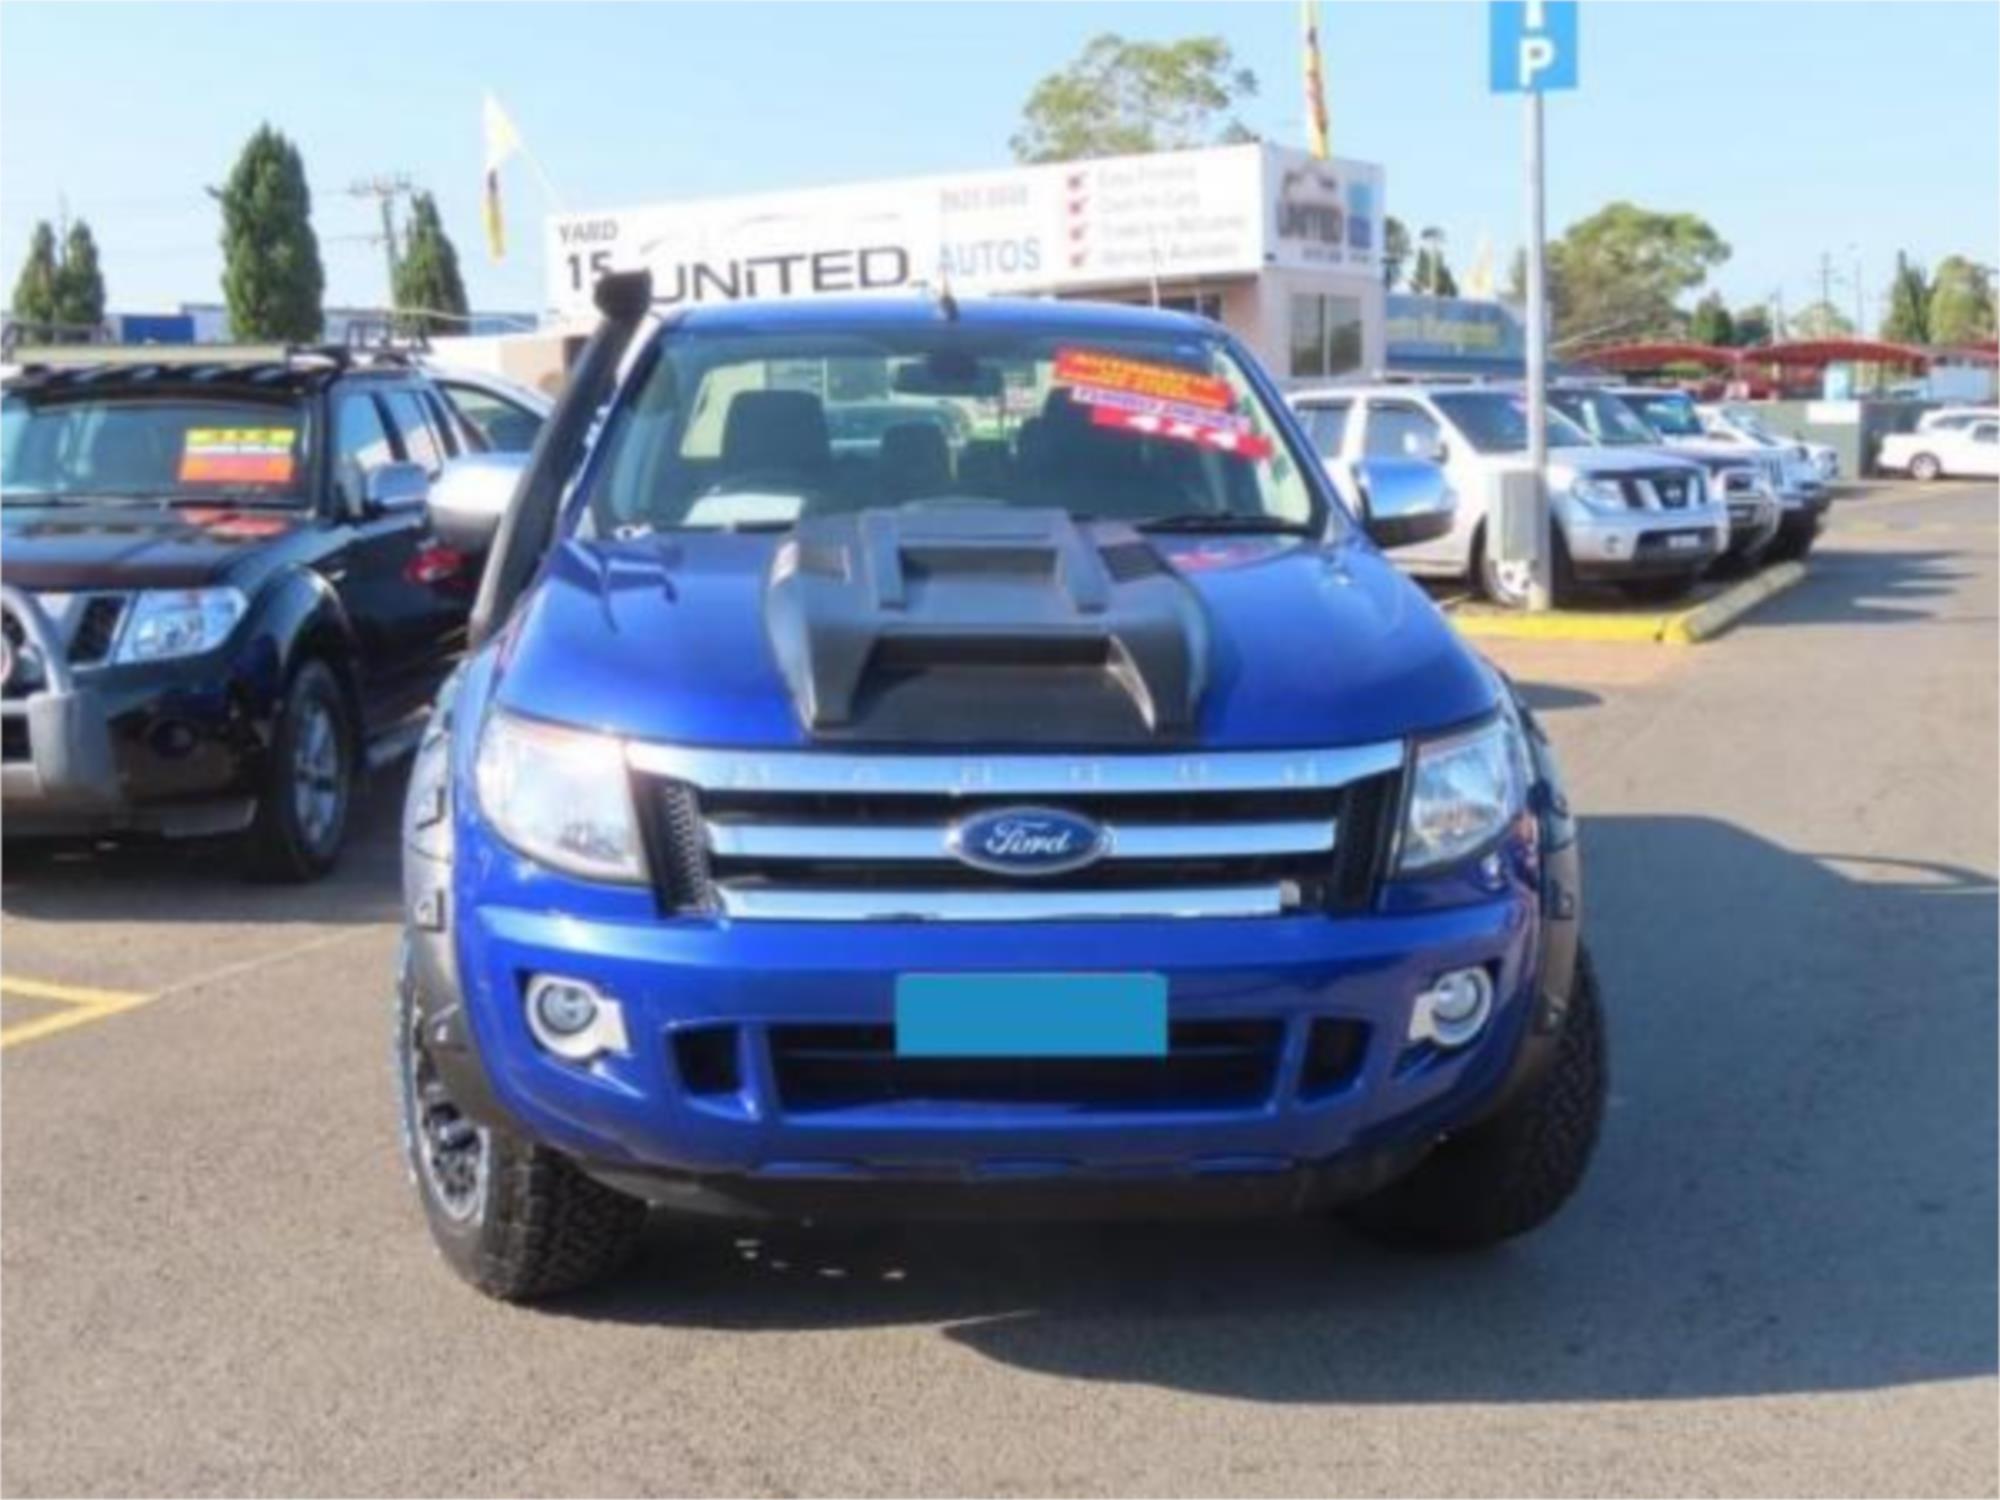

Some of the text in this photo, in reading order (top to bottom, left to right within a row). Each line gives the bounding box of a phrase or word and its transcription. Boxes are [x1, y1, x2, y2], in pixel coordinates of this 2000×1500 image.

[559, 219, 619, 243] YARD
[938, 237, 1042, 278] AUTOS
[985, 819, 1073, 855] Ford
